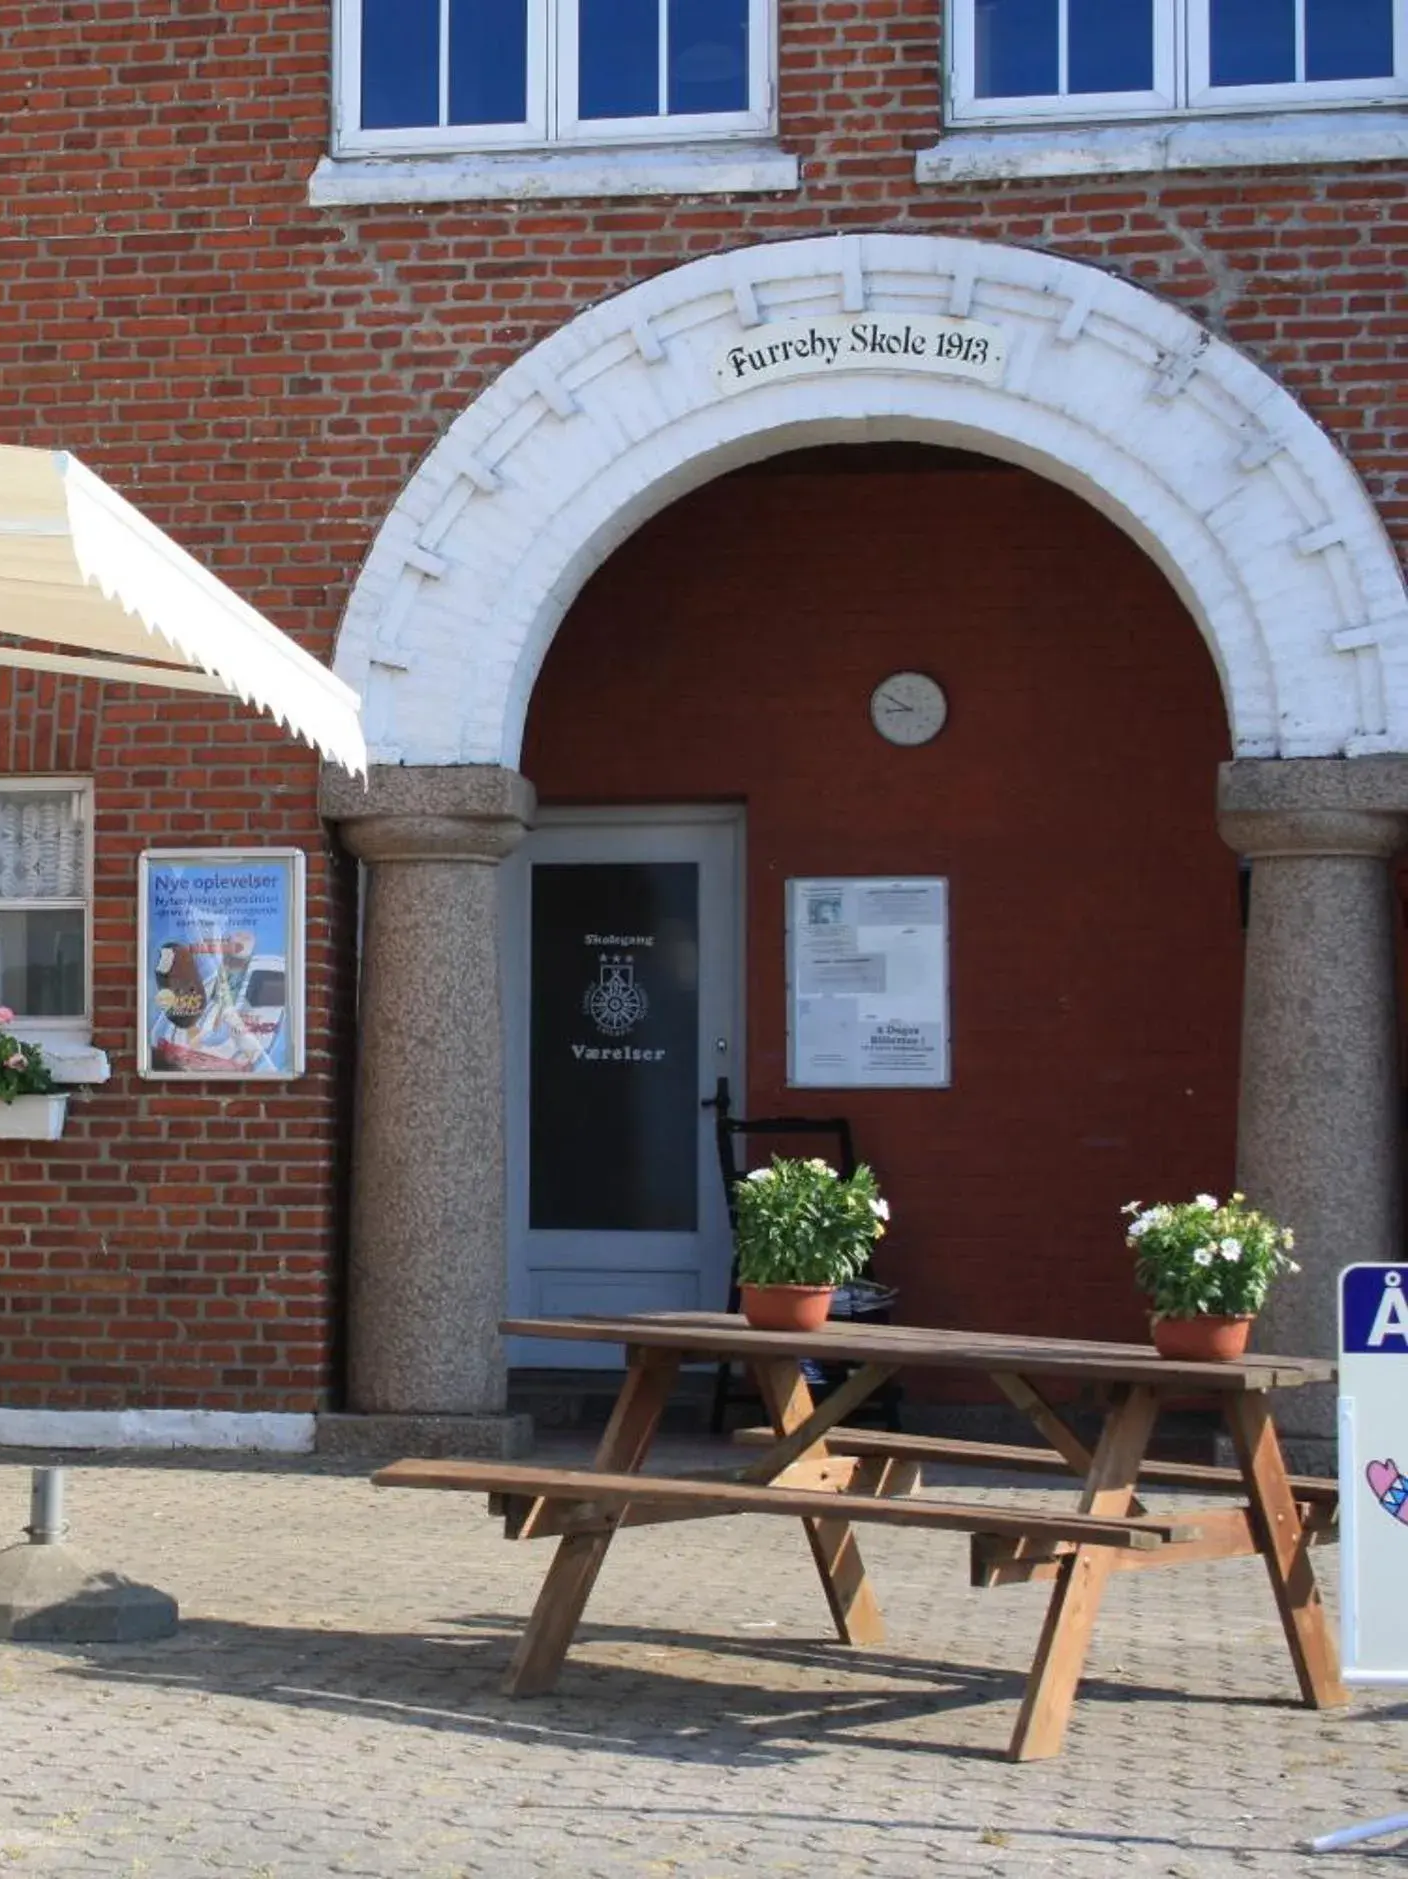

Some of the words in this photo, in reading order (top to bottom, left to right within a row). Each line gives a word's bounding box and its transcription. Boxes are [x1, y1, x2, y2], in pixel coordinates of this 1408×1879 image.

[727, 328, 840, 378] Furreby
[849, 323, 927, 356] Skole
[936, 331, 989, 366] 1913
[154, 875, 189, 894] Nye
[571, 1045, 666, 1061] Værelser
[1366, 1270, 1408, 1346] Å
